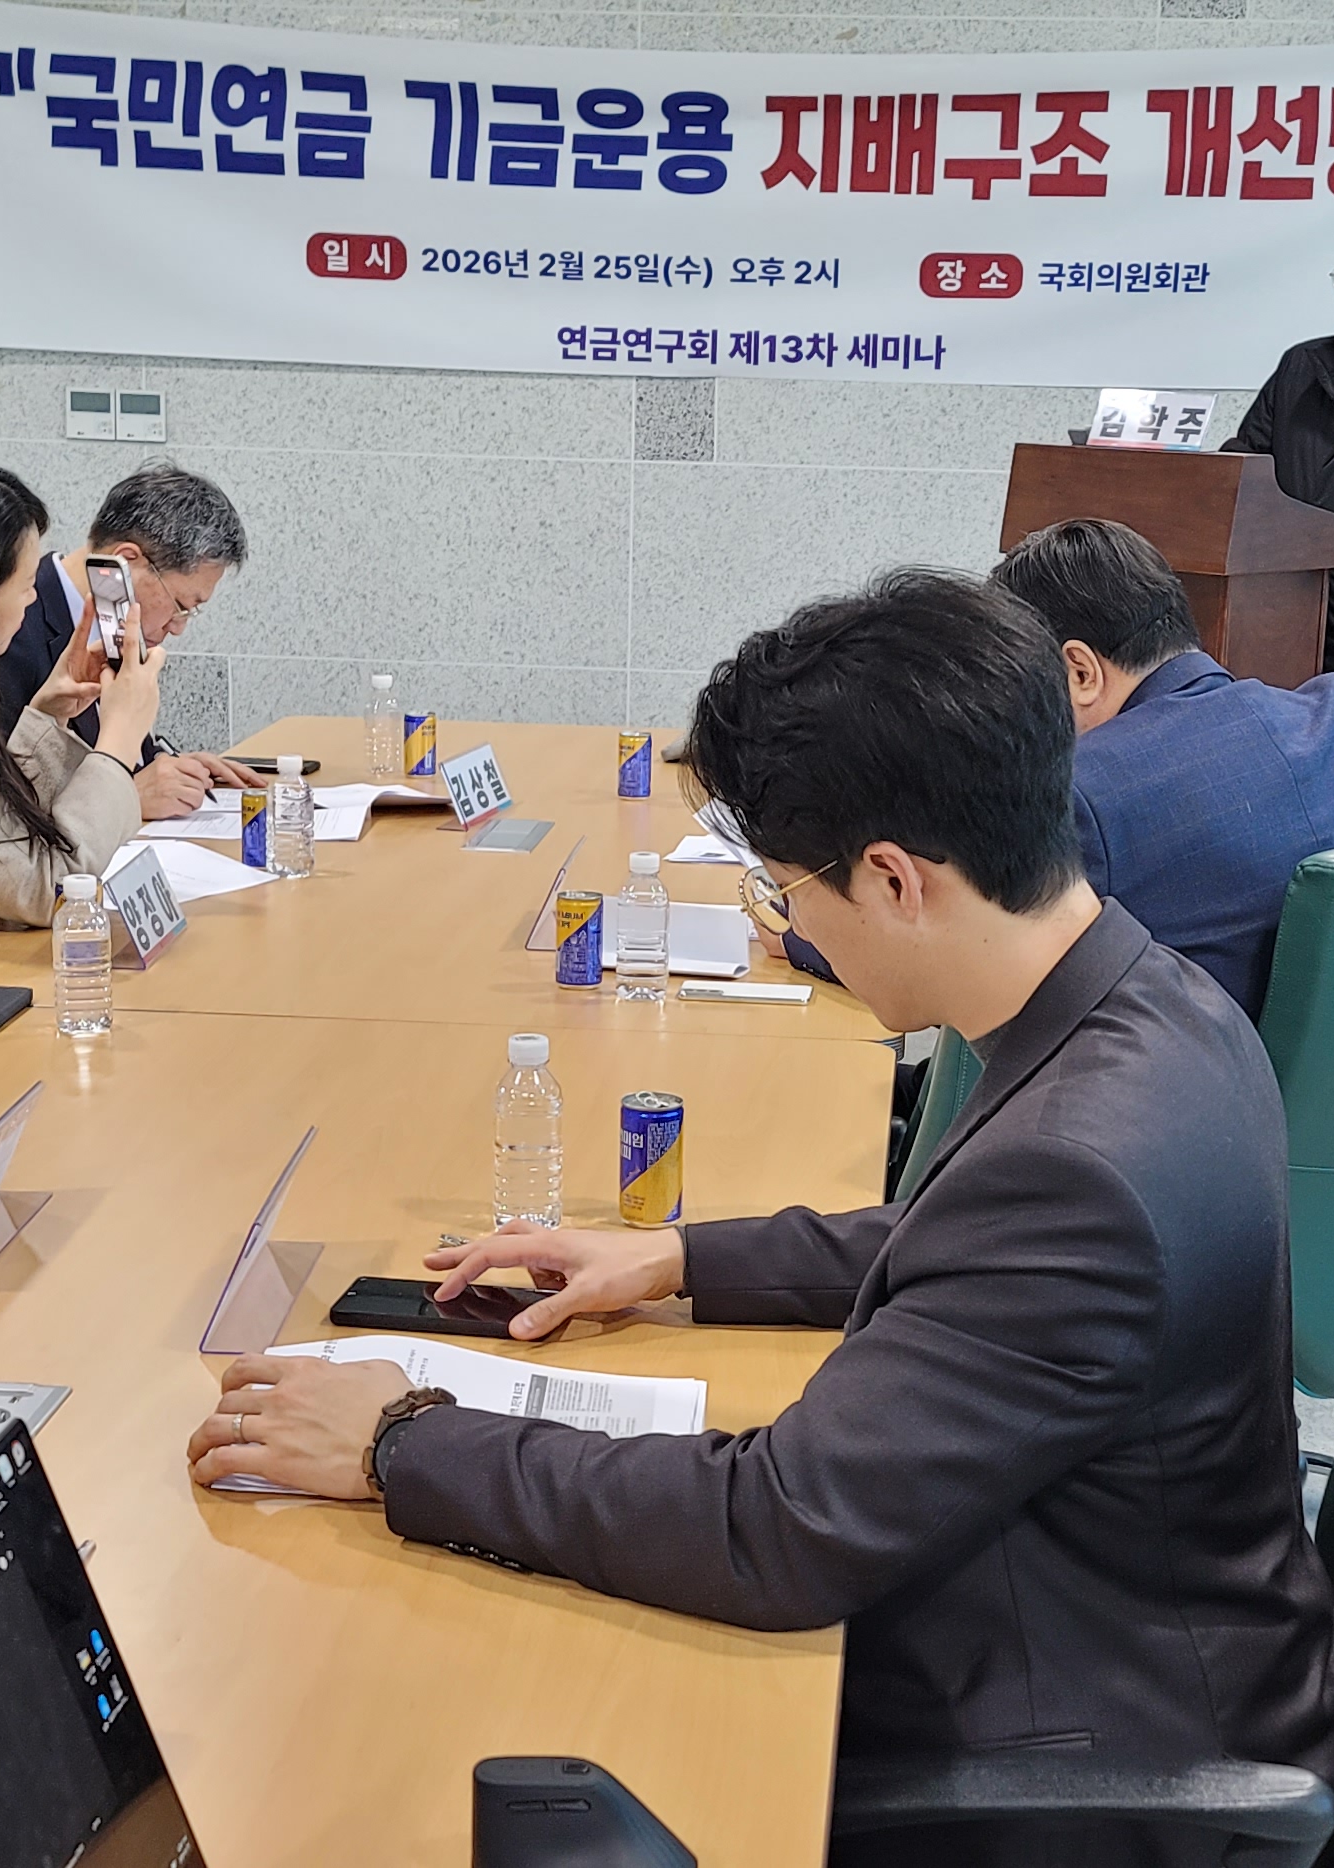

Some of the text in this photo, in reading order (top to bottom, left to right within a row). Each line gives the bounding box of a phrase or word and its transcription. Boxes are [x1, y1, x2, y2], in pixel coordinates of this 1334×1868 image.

[404, 80, 734, 195] 기금운용
[761, 91, 1110, 201] 지배구조
[422, 248, 840, 289] 2026년 2월 25일(수) 오후 2시
[1038, 262, 1210, 293] 국회의원회관
[557, 325, 946, 370] 연금연구회 제13차 세미나
